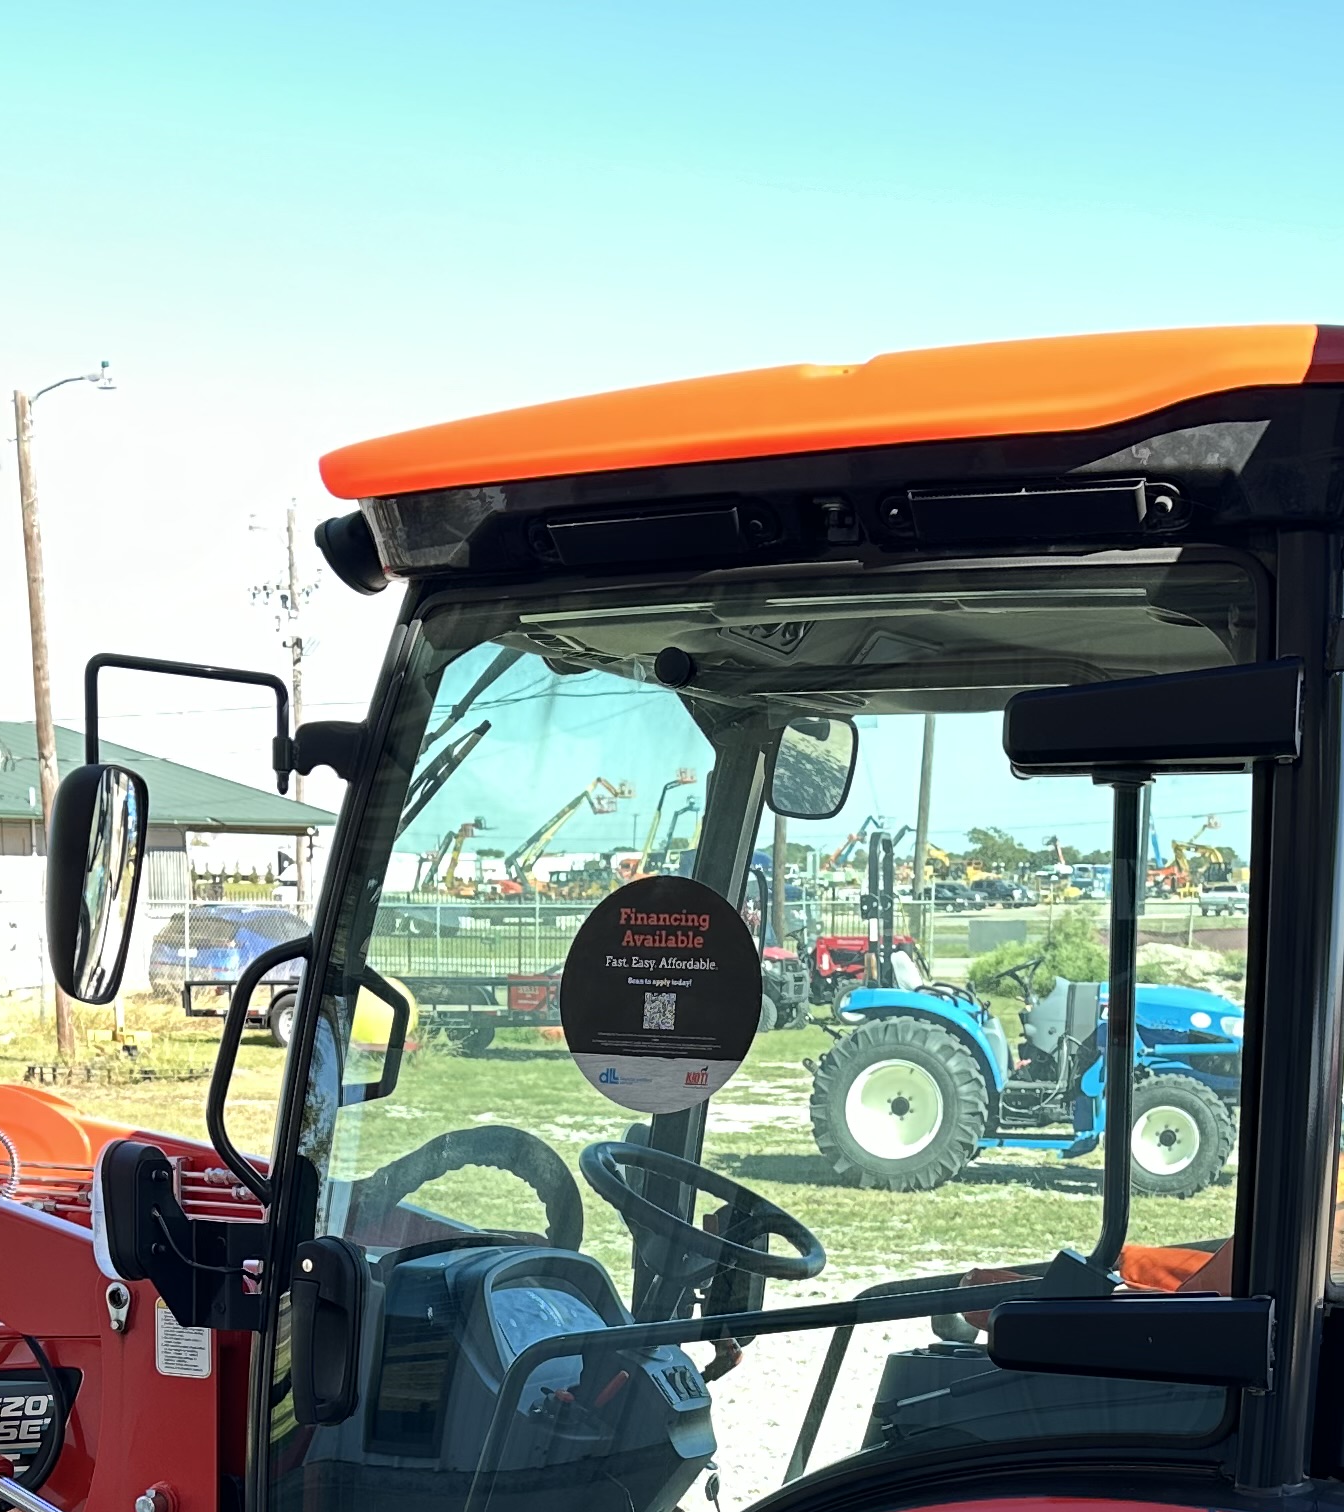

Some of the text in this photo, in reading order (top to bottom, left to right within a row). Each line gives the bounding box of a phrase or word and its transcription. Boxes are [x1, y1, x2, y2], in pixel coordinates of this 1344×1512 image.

[619, 908, 710, 931] Financing
[622, 930, 704, 949] Available
[605, 956, 629, 968] Fast.
[659, 957, 718, 971] Affordable.
